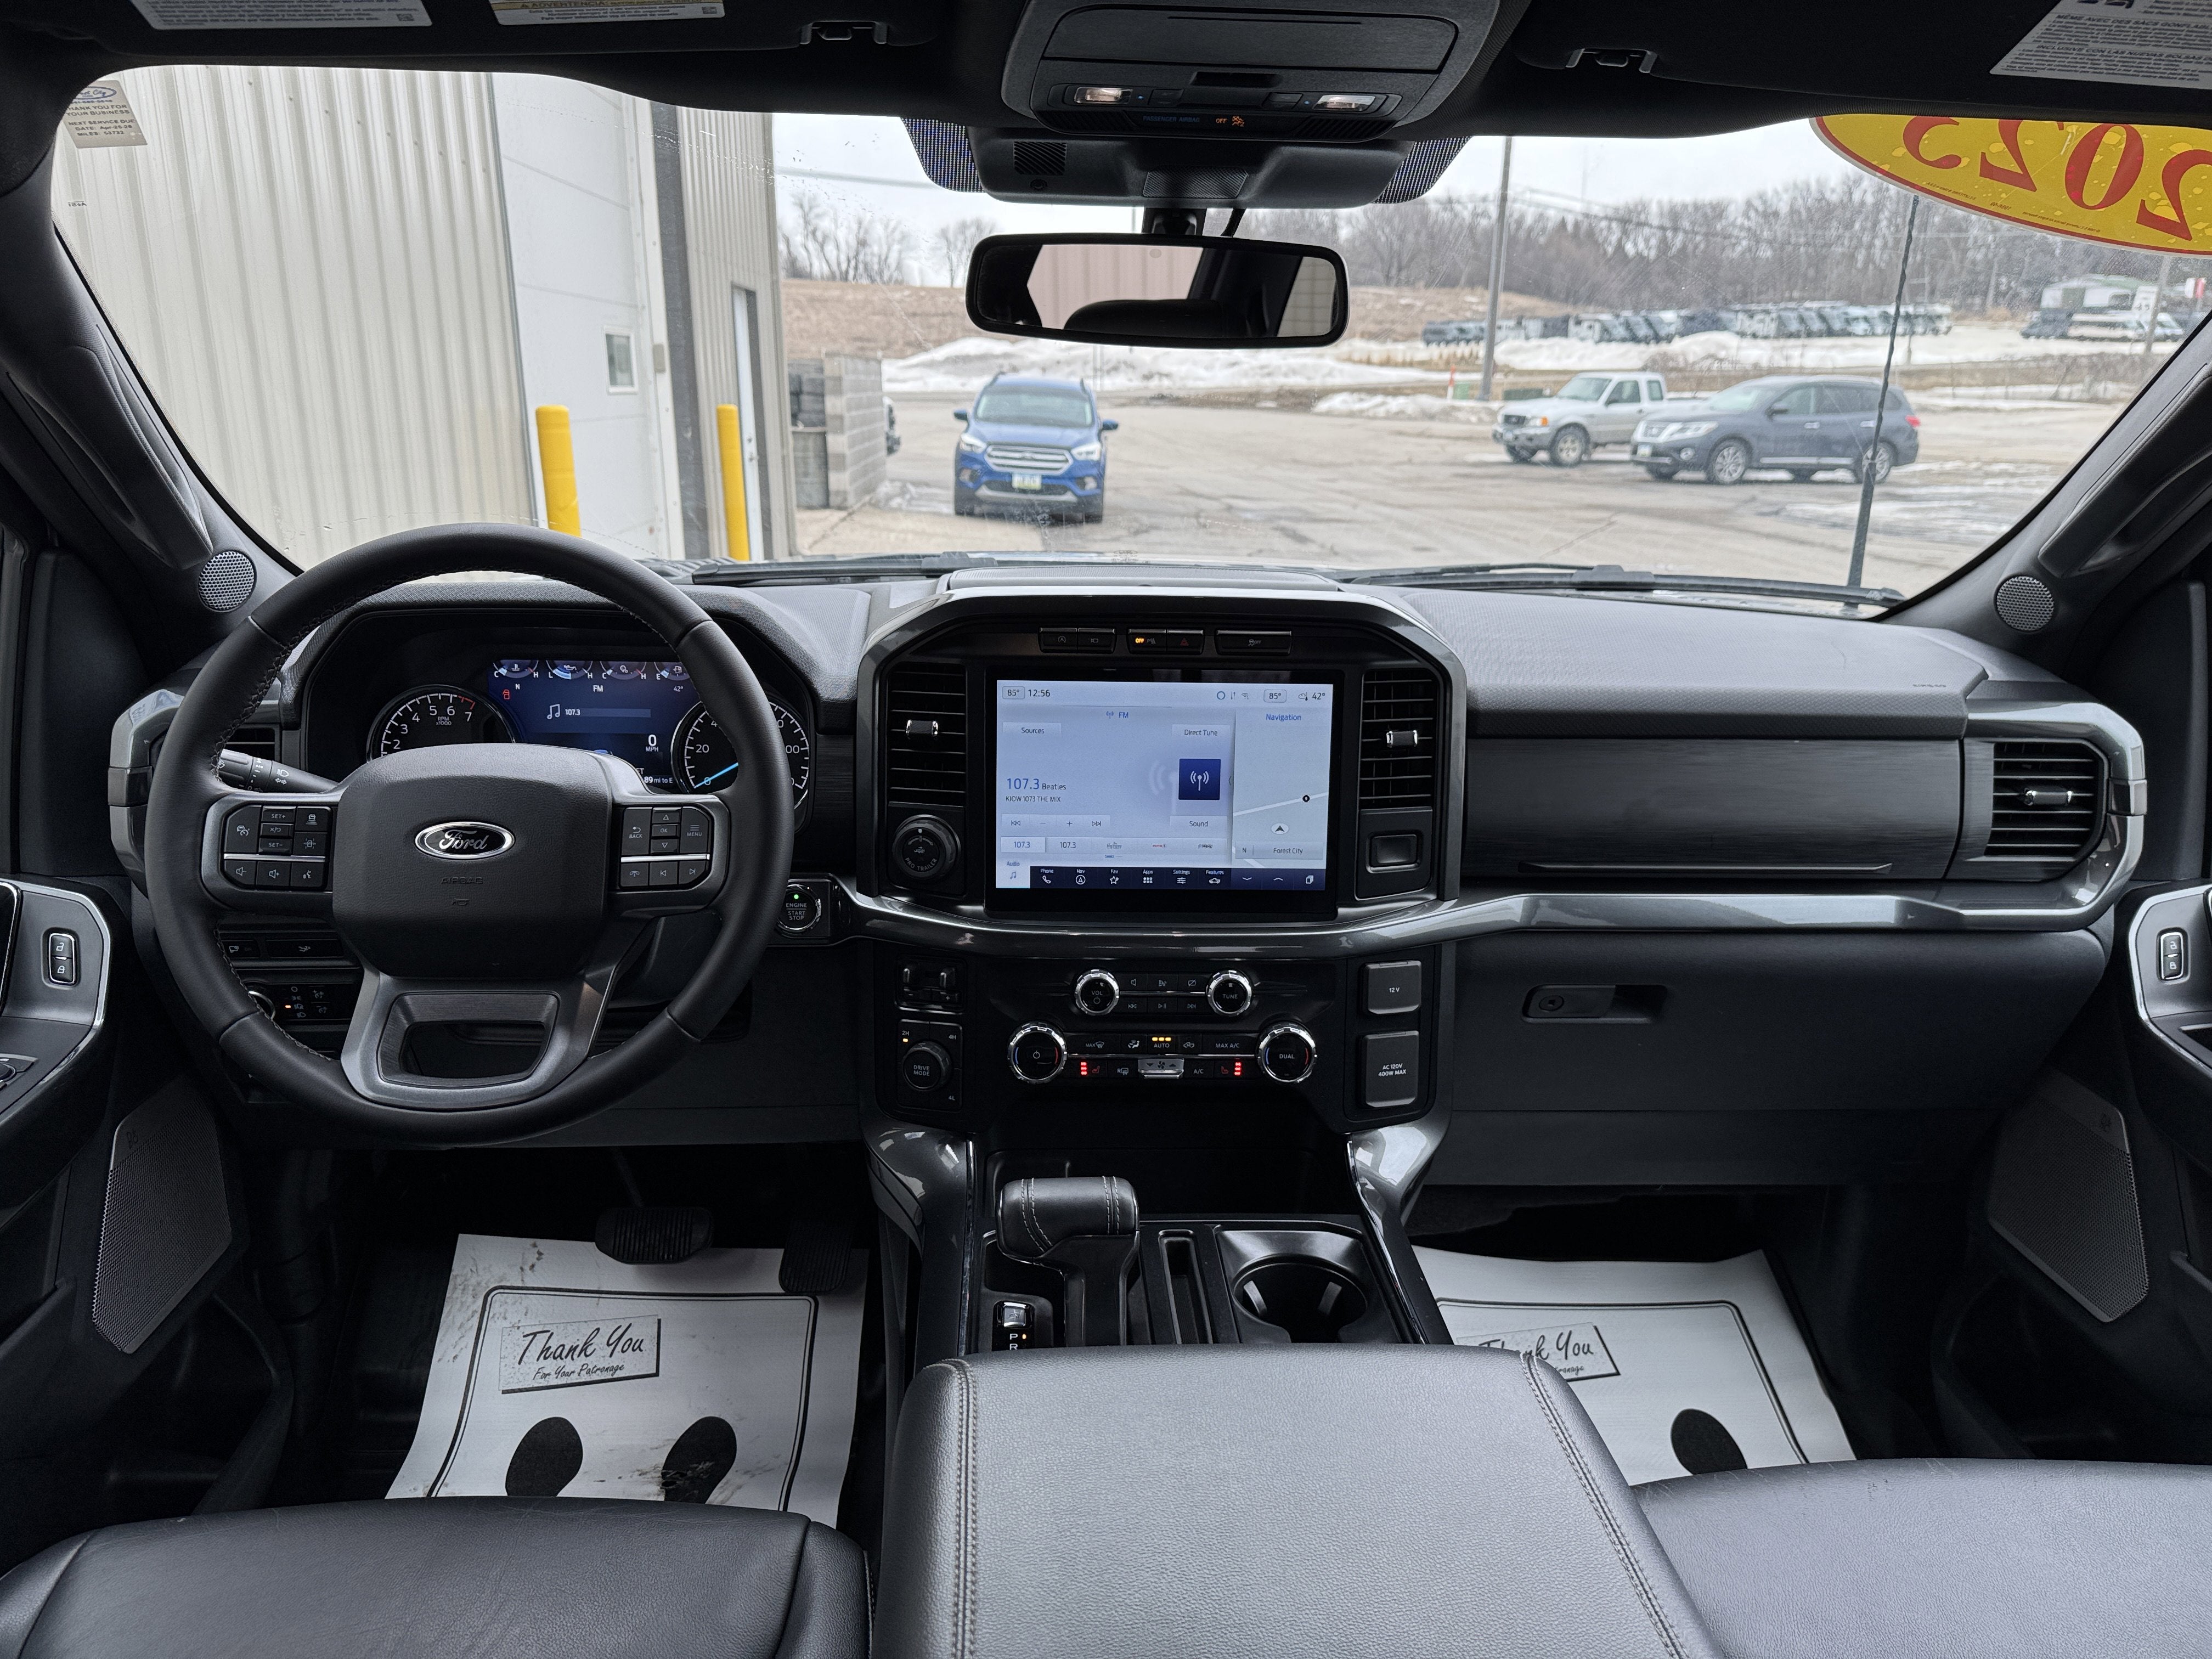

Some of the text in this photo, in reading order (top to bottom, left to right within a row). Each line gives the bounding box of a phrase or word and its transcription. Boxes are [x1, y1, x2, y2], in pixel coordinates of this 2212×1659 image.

[429, 706, 438, 715] 5
[447, 706, 455, 716] 6
[412, 713, 420, 723] 4
[465, 712, 472, 722] 7
[1266, 714, 1301, 722] Navigation
[400, 724, 408, 734] 3
[393, 740, 400, 749] 2
[648, 734, 657, 746] 0
[696, 744, 710, 753] 20
[1007, 778, 1040, 789] 107.3
[439, 830, 490, 849] Ford
[905, 857, 938, 871] PRO TRAILER
[517, 1322, 644, 1365] Thank You
[1556, 1330, 1594, 1360] You
[533, 1363, 625, 1381] For Your Patronage
